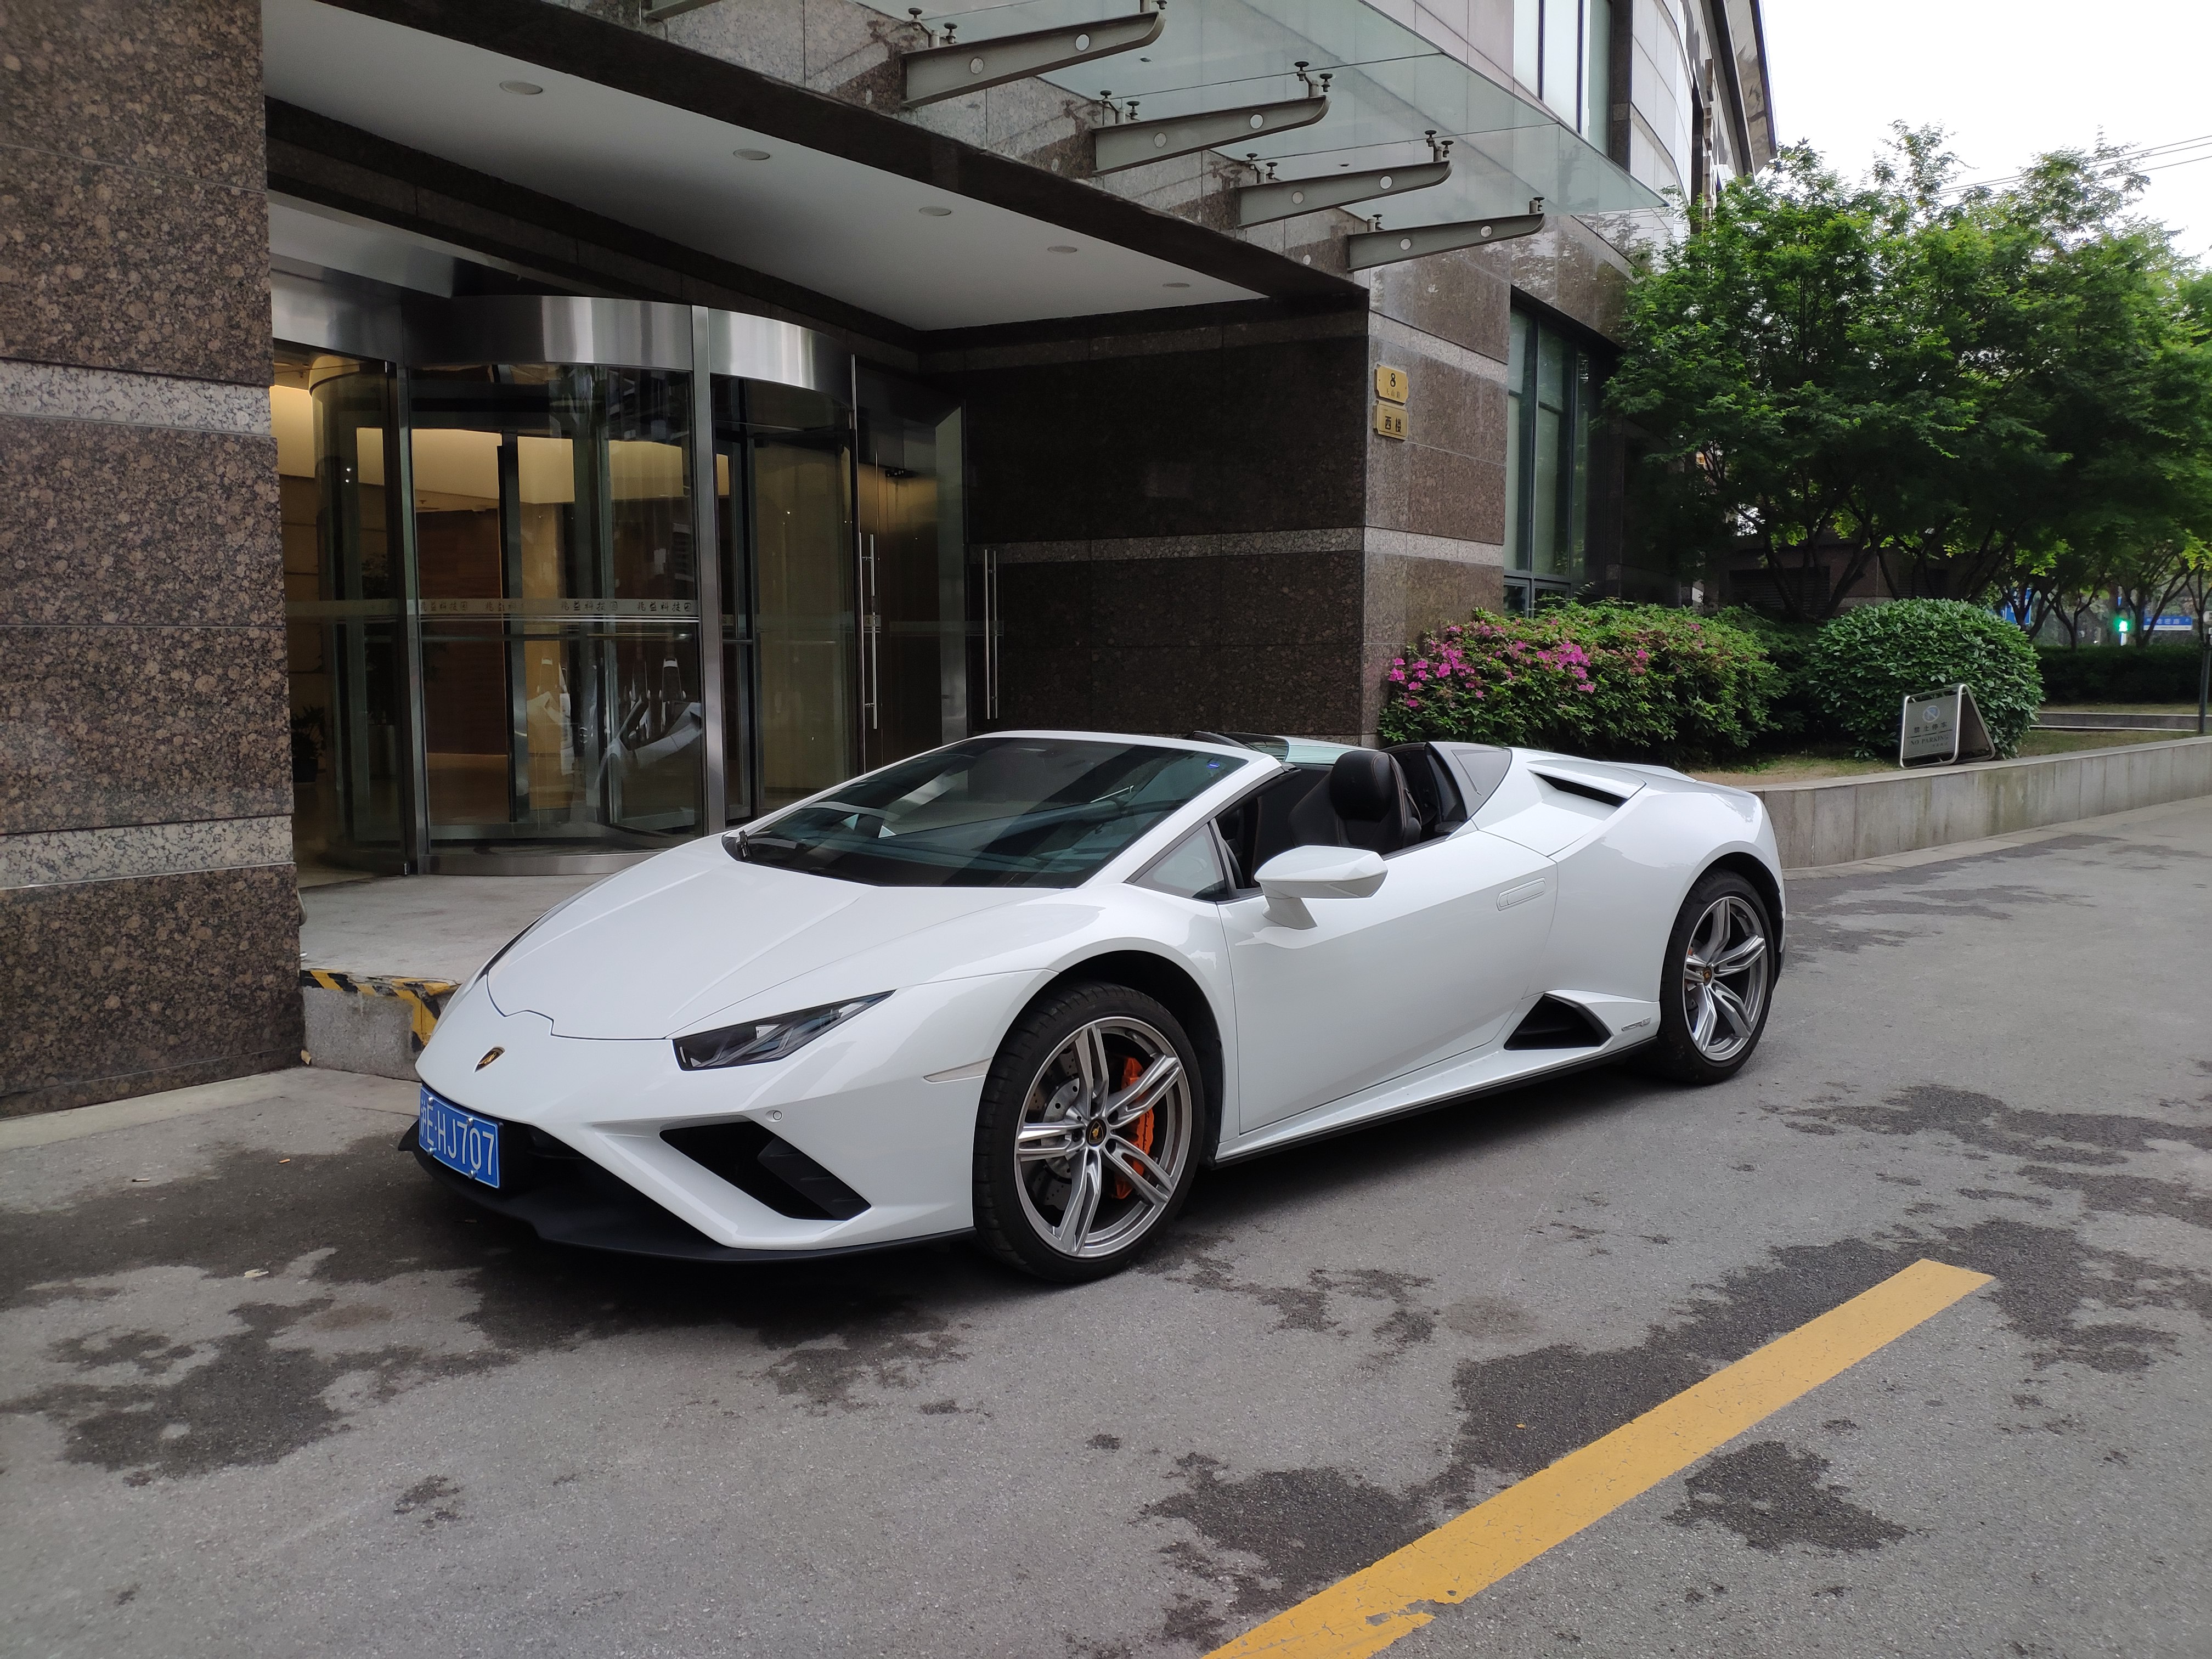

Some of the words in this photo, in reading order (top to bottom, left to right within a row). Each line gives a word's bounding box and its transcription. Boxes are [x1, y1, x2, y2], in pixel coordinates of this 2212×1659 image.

[1390, 373, 1396, 387] 8
[1914, 721, 1948, 733] 禁止停车
[1922, 734, 1949, 744] PARKING
